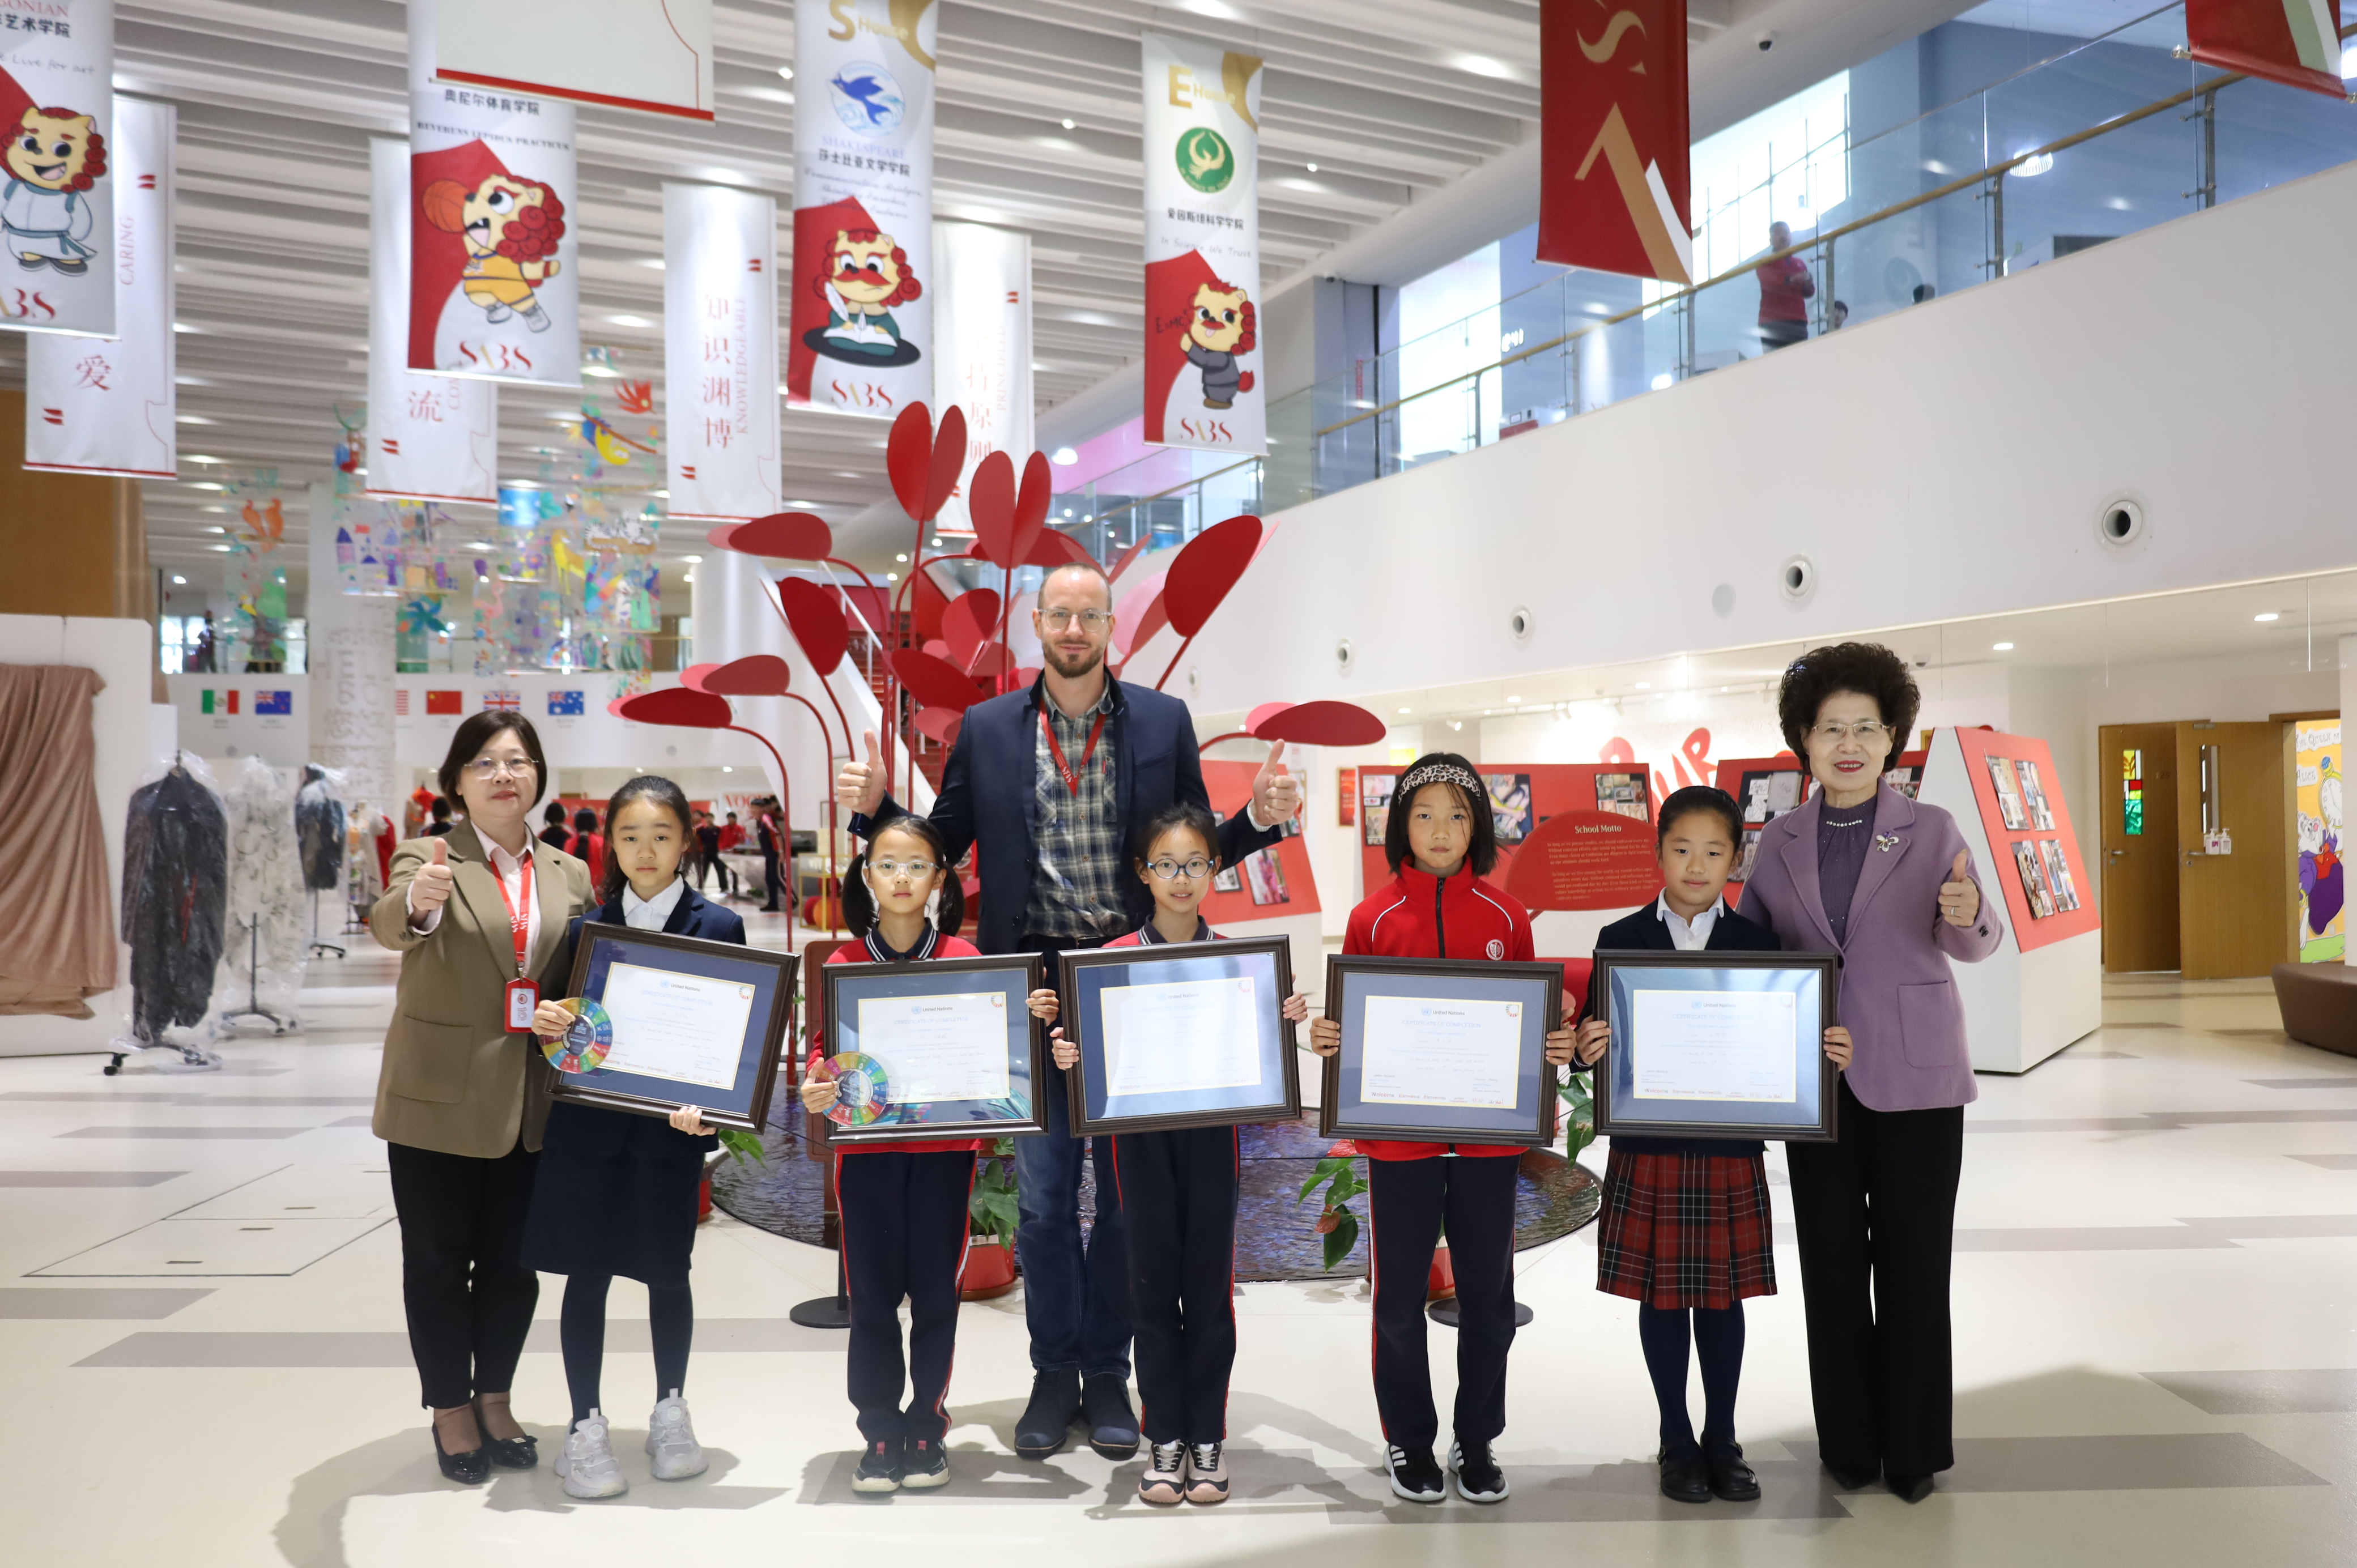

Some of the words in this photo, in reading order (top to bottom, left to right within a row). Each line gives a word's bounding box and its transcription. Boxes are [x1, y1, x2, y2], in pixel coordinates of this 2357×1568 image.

[0, 14, 71, 37] 艺术学院
[858, 16, 908, 40] House
[1169, 65, 1192, 109] E
[1194, 83, 1236, 105] House
[819, 148, 911, 177] 莎士比亚文学学院
[1168, 207, 1245, 231] 爱因斯坦科学学院
[119, 216, 135, 286] CARING
[1173, 237, 1204, 251] Science
[1209, 245, 1222, 253] We
[1228, 247, 1252, 258] Trust
[704, 293, 734, 449] 知识渊博
[735, 295, 748, 434] KNOWLEDGEABLE
[1575, 825, 1599, 834] School
[1600, 824, 1622, 833] Motto
